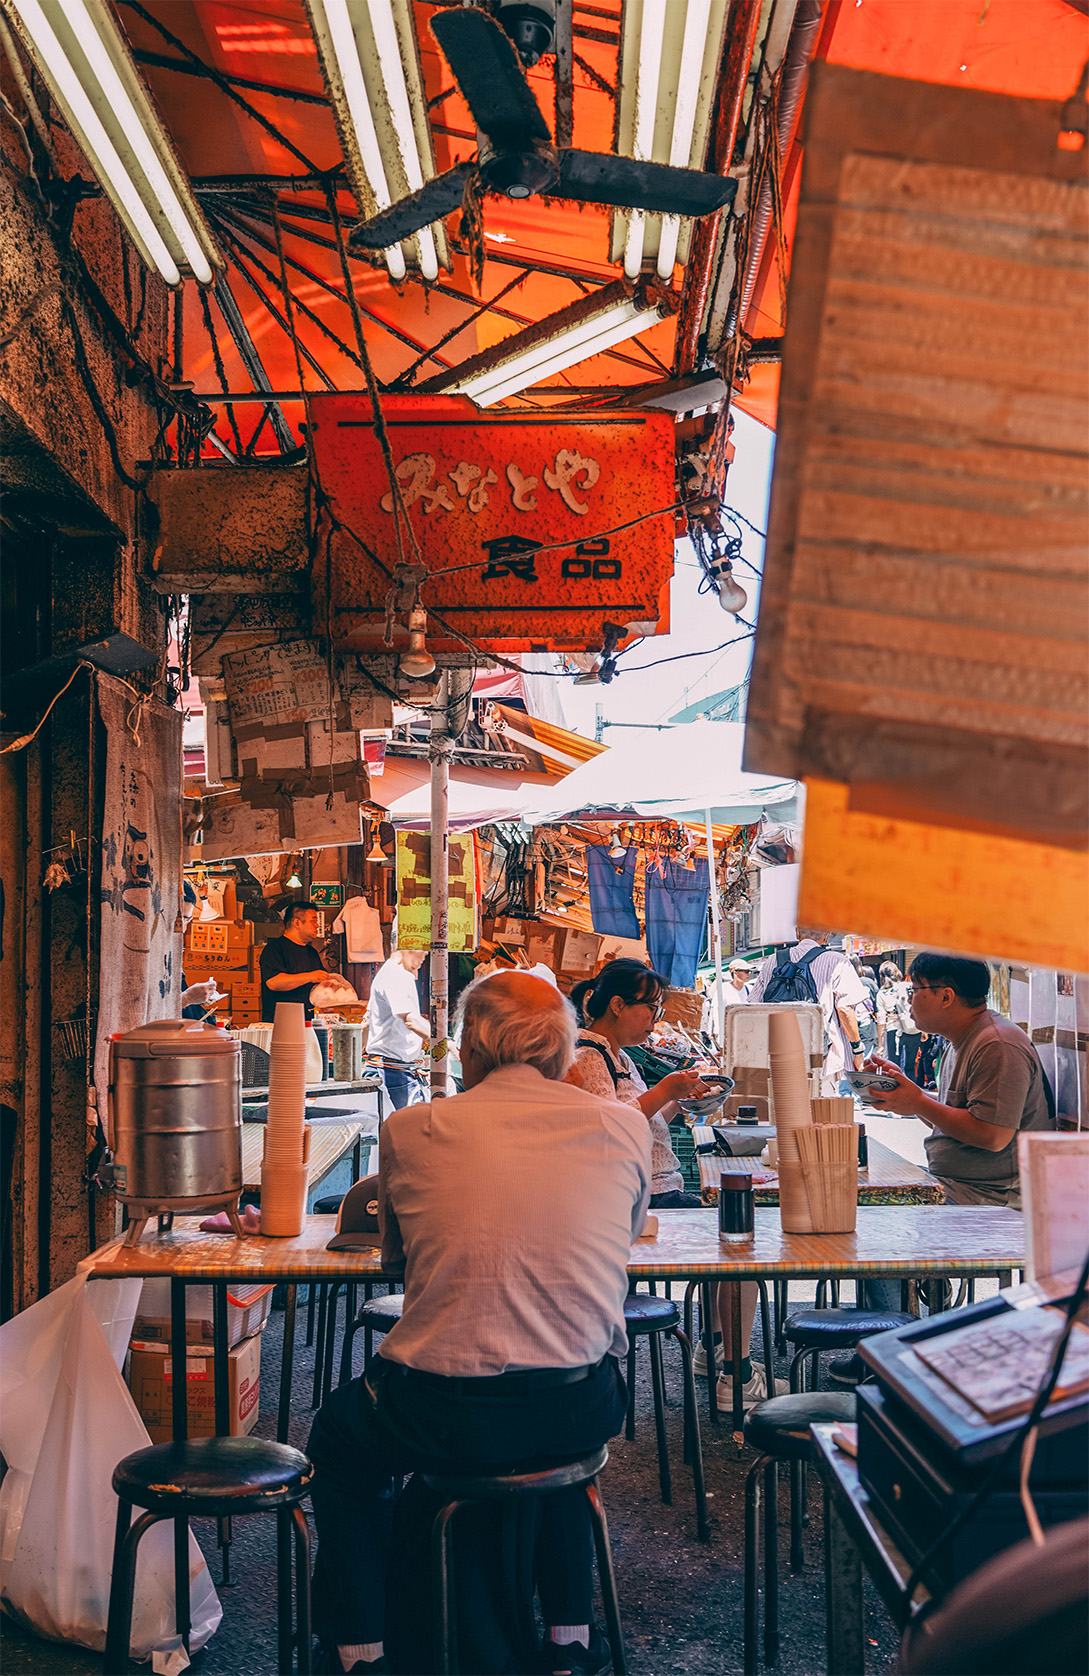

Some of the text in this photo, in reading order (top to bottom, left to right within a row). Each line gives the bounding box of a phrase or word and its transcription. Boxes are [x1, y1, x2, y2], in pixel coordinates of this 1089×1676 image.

[380, 448, 602, 516] みなとや
[481, 534, 622, 582] 食品
